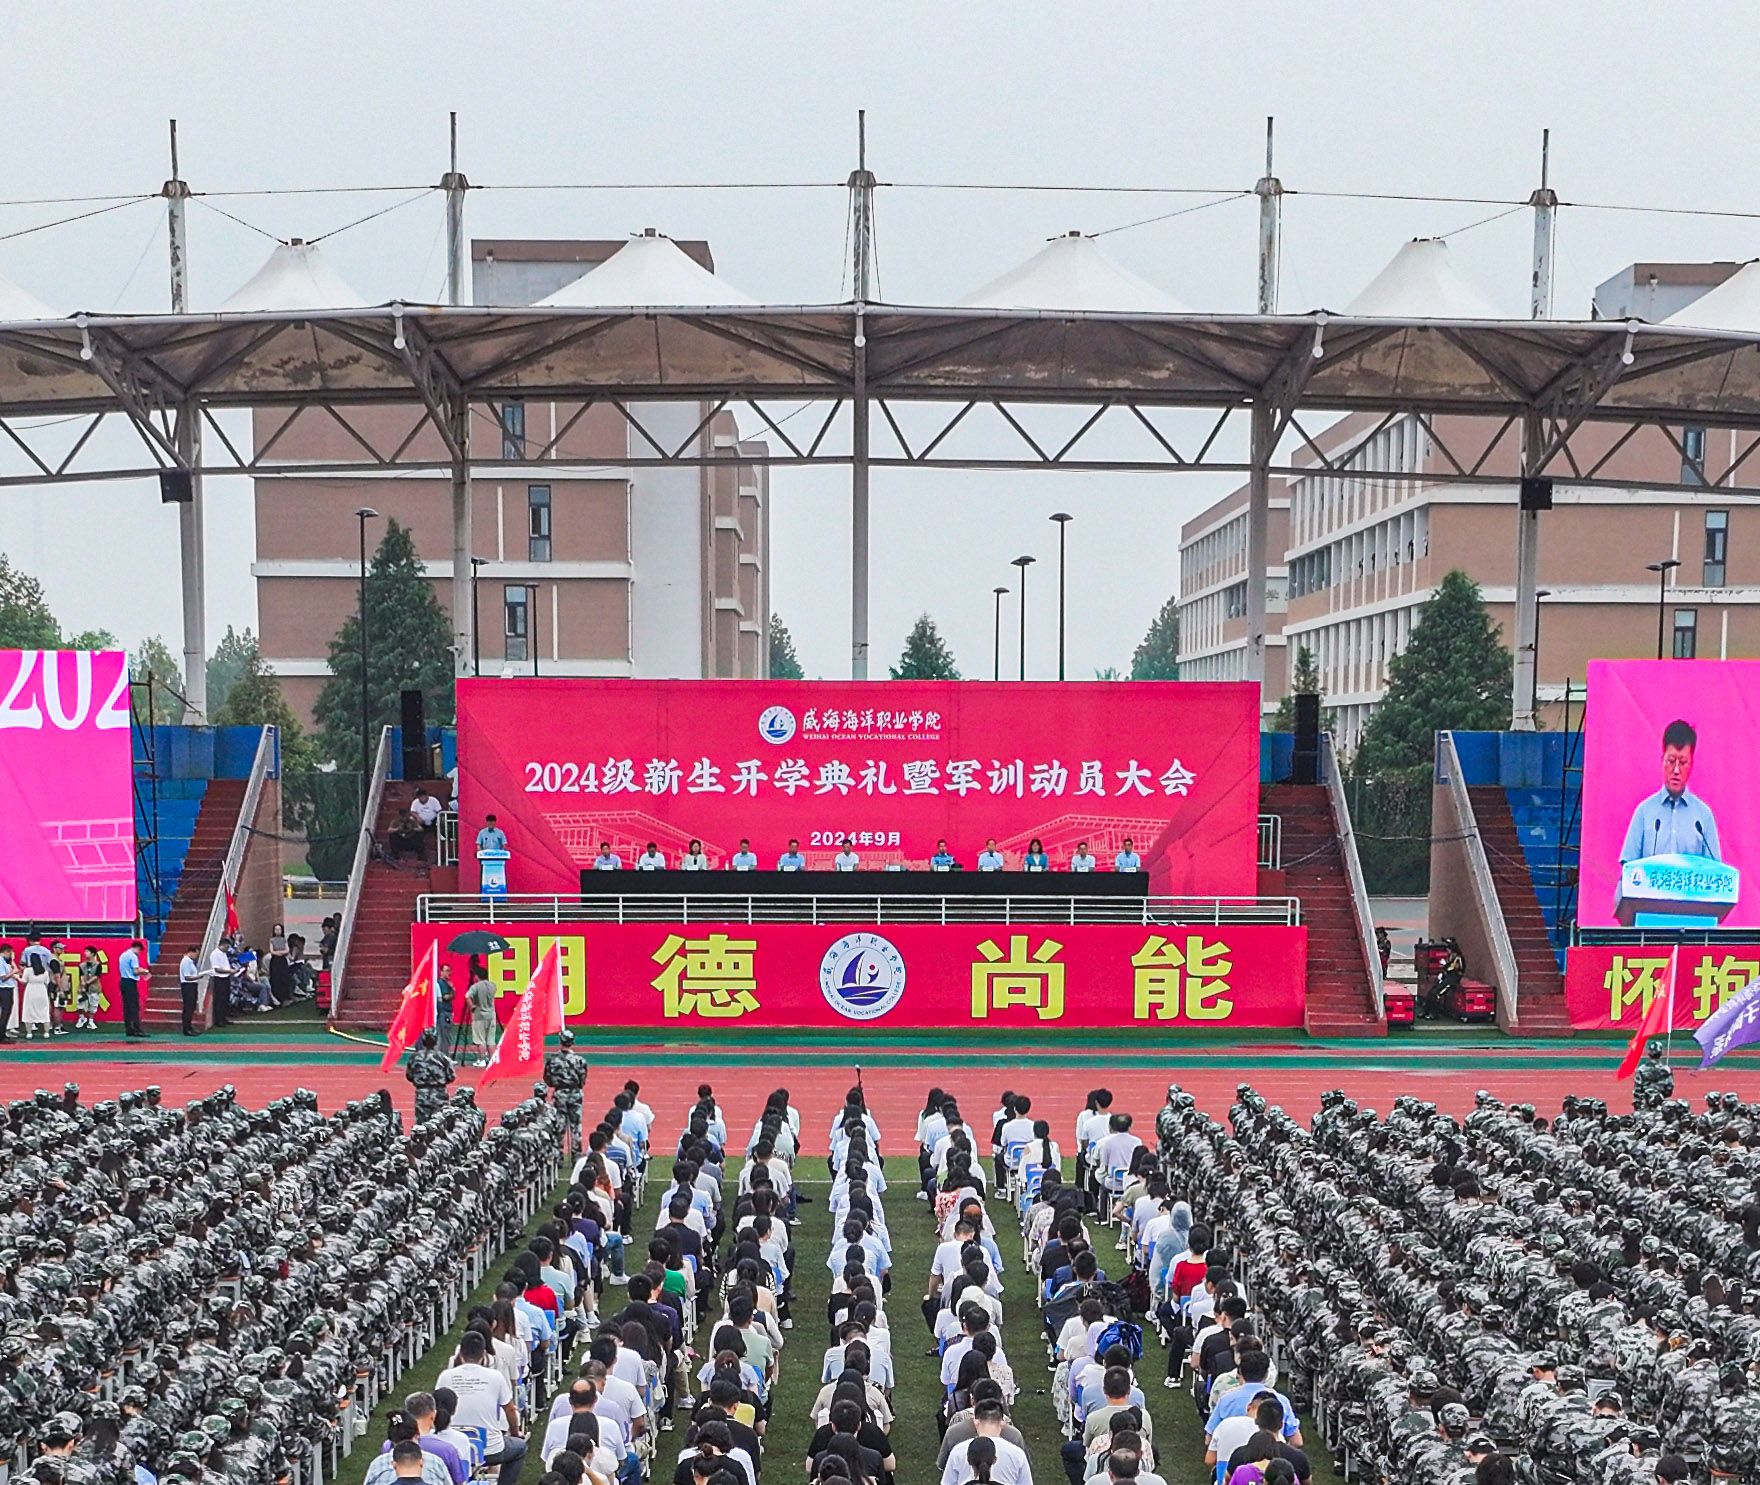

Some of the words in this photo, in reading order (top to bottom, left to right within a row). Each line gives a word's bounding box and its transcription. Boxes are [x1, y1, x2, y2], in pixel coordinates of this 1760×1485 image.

[803, 708, 941, 733] 威海海洋职业学院
[524, 756, 1197, 798] 2024级新生开学典礼暨军训动员大会
[810, 831, 900, 846] 2024年9月
[1648, 868, 1733, 893] 威海海洋职业学院
